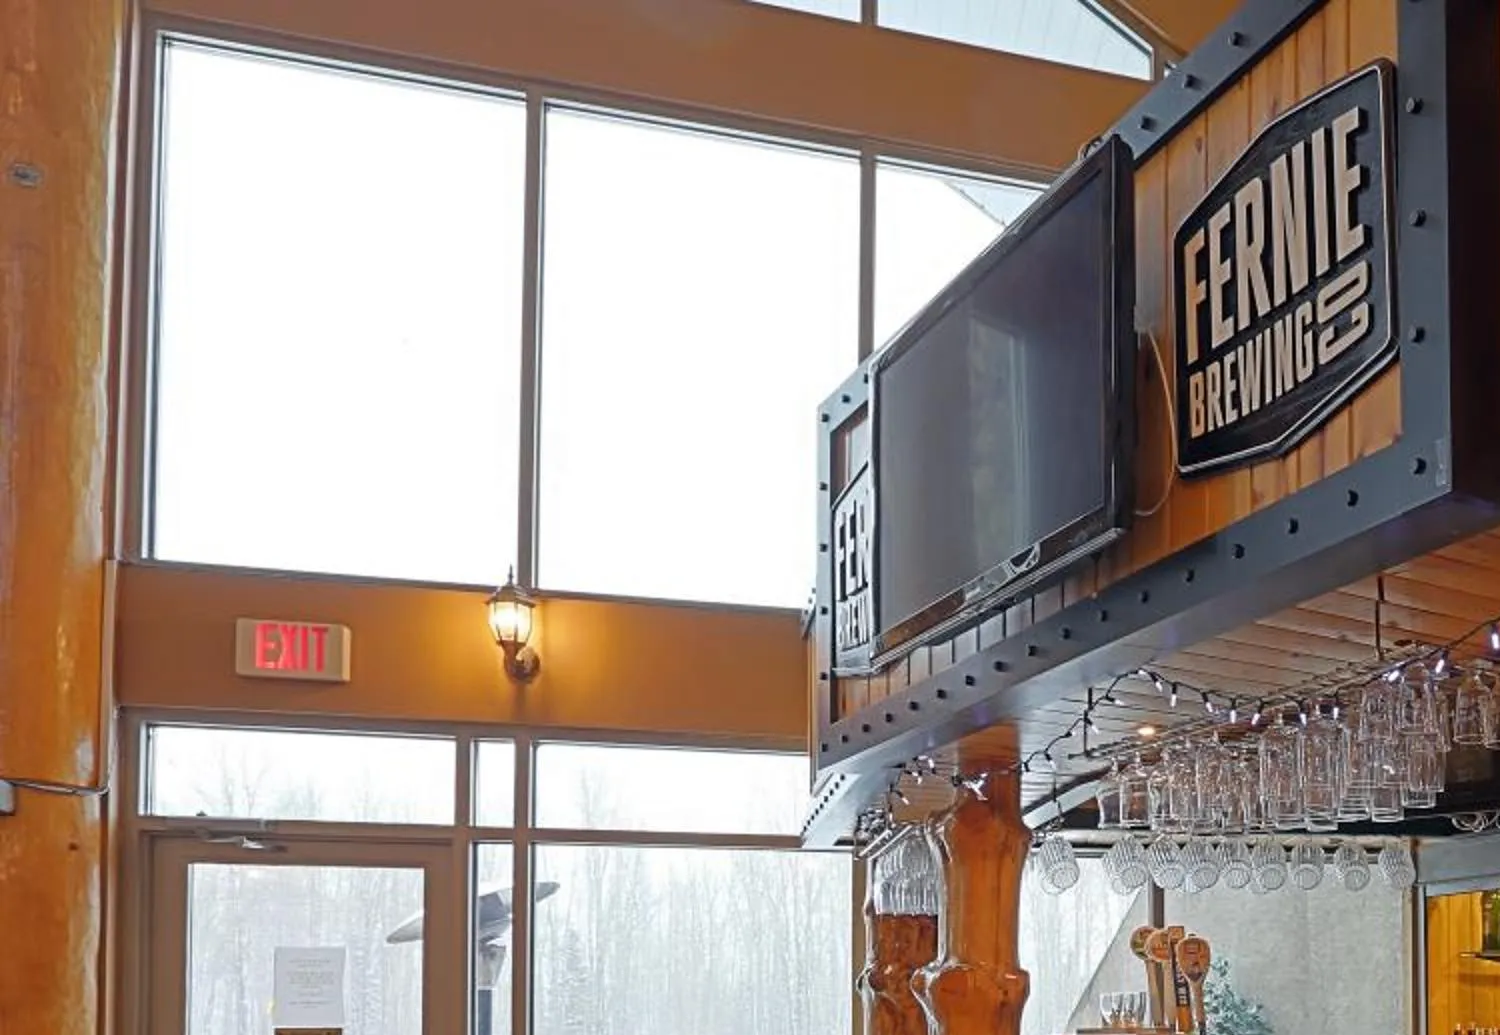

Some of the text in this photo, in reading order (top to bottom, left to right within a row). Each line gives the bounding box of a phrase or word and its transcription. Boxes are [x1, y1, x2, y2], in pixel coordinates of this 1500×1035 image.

[1185, 106, 1366, 365] FERNIE
[1189, 300, 1315, 440] BREWING
[1317, 260, 1369, 365] CO
[255, 622, 329, 672] EXIT
